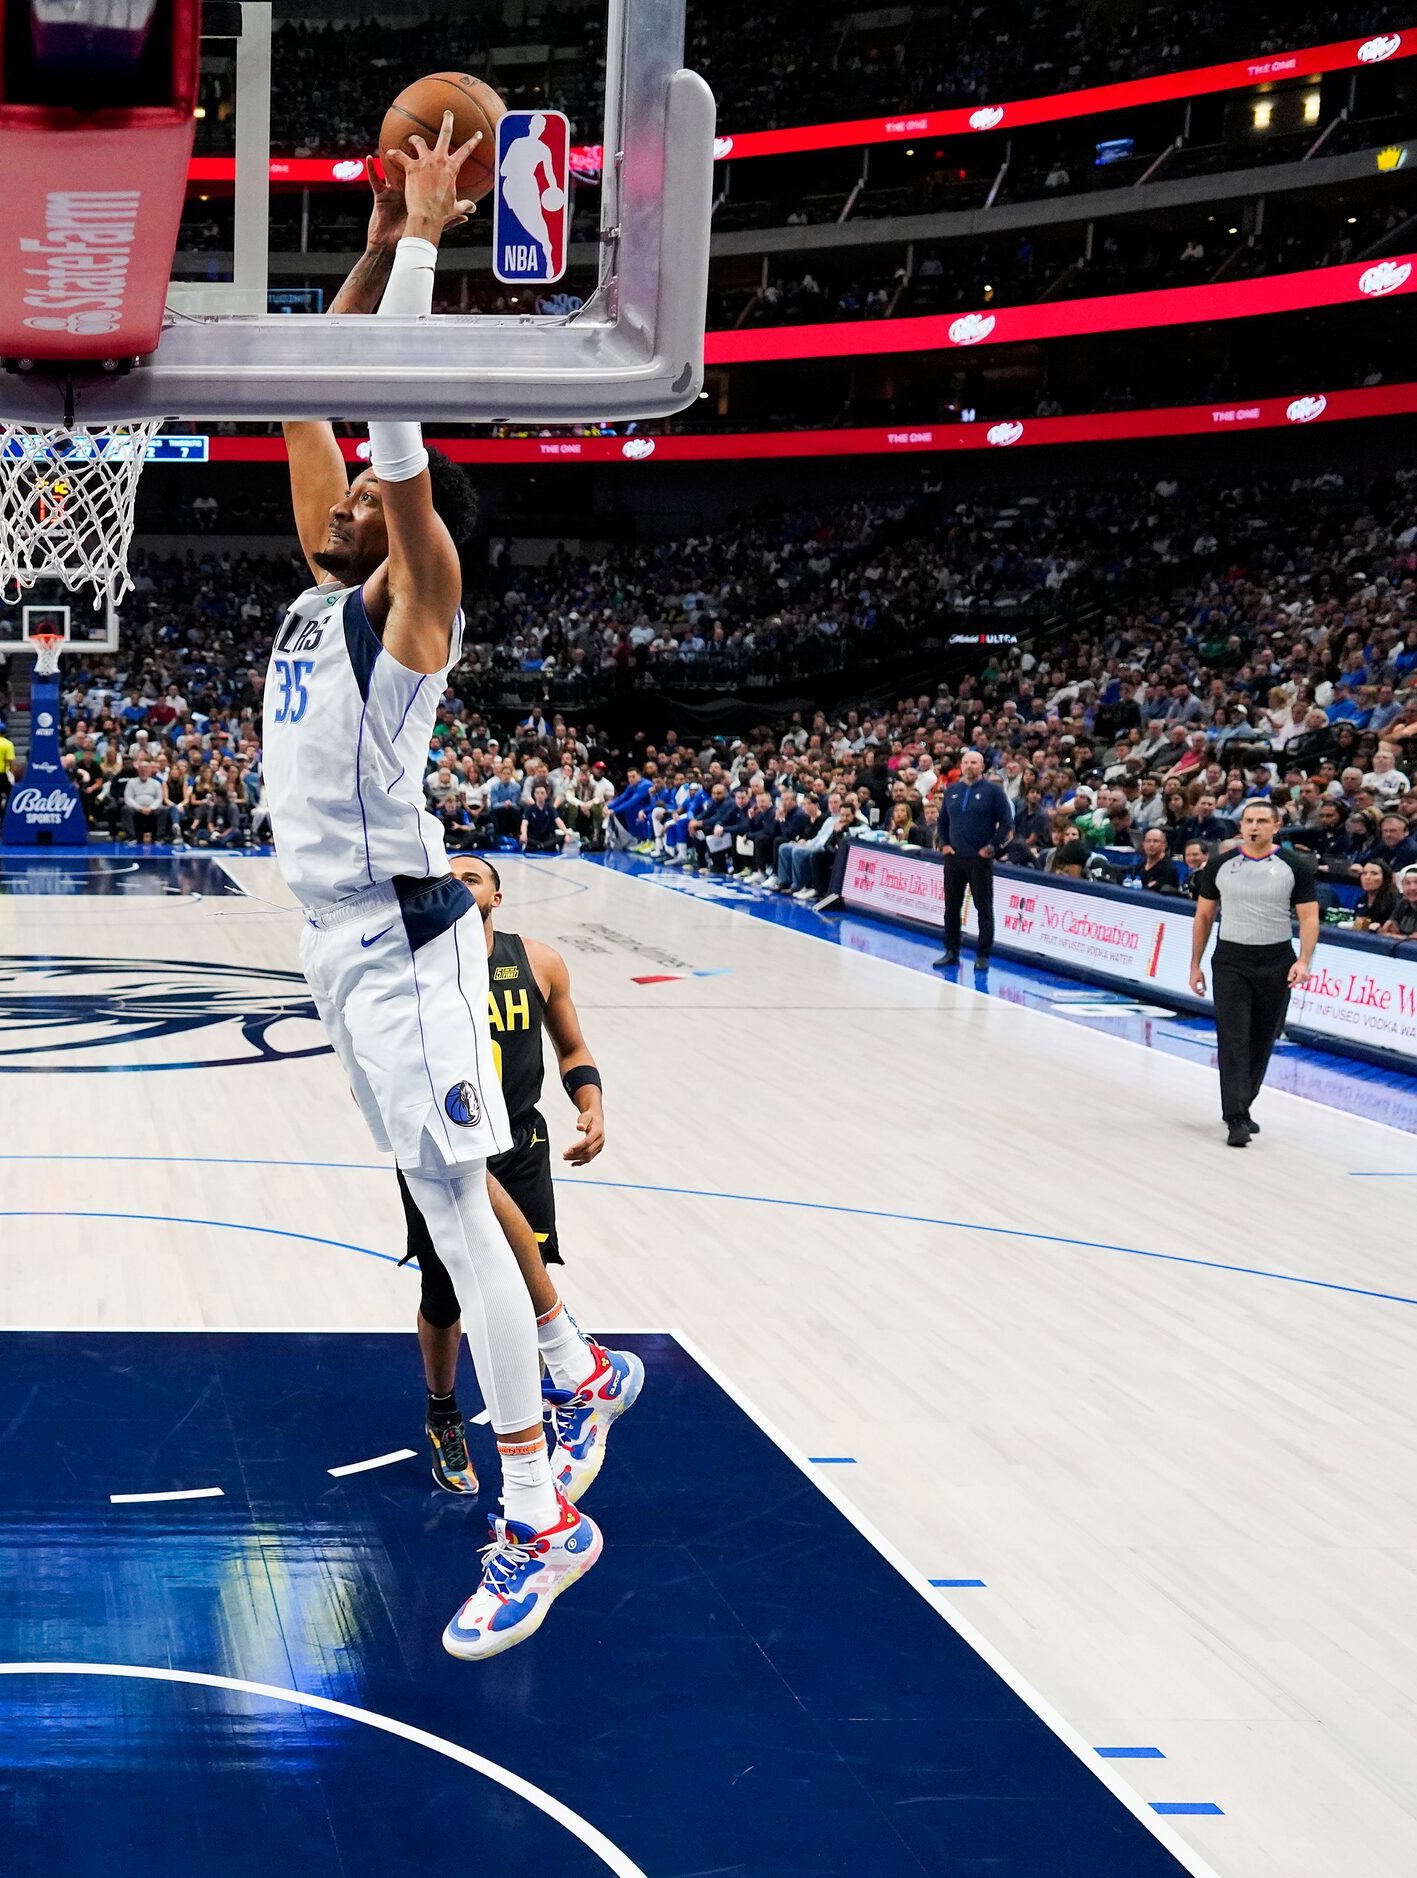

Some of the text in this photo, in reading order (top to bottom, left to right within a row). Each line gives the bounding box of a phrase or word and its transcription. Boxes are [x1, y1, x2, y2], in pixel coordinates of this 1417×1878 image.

[1247, 58, 1297, 75] THE ONE
[885, 120, 905, 133] THE
[505, 245, 538, 271] NBA
[1212, 407, 1260, 422] THE ONE
[887, 432, 932, 443] THE ONE
[181, 447, 189, 458] 7
[540, 444, 581, 453] THE ONE
[273, 660, 314, 724] 35
[12, 788, 77, 819] Bally
[26, 812, 62, 824] SPORTS
[1041, 904, 1140, 950] No Carbonation
[1345, 974, 1392, 1010] Like
[1316, 1002, 1361, 1024] INFUSED
[1362, 1014, 1399, 1033] VODKA
